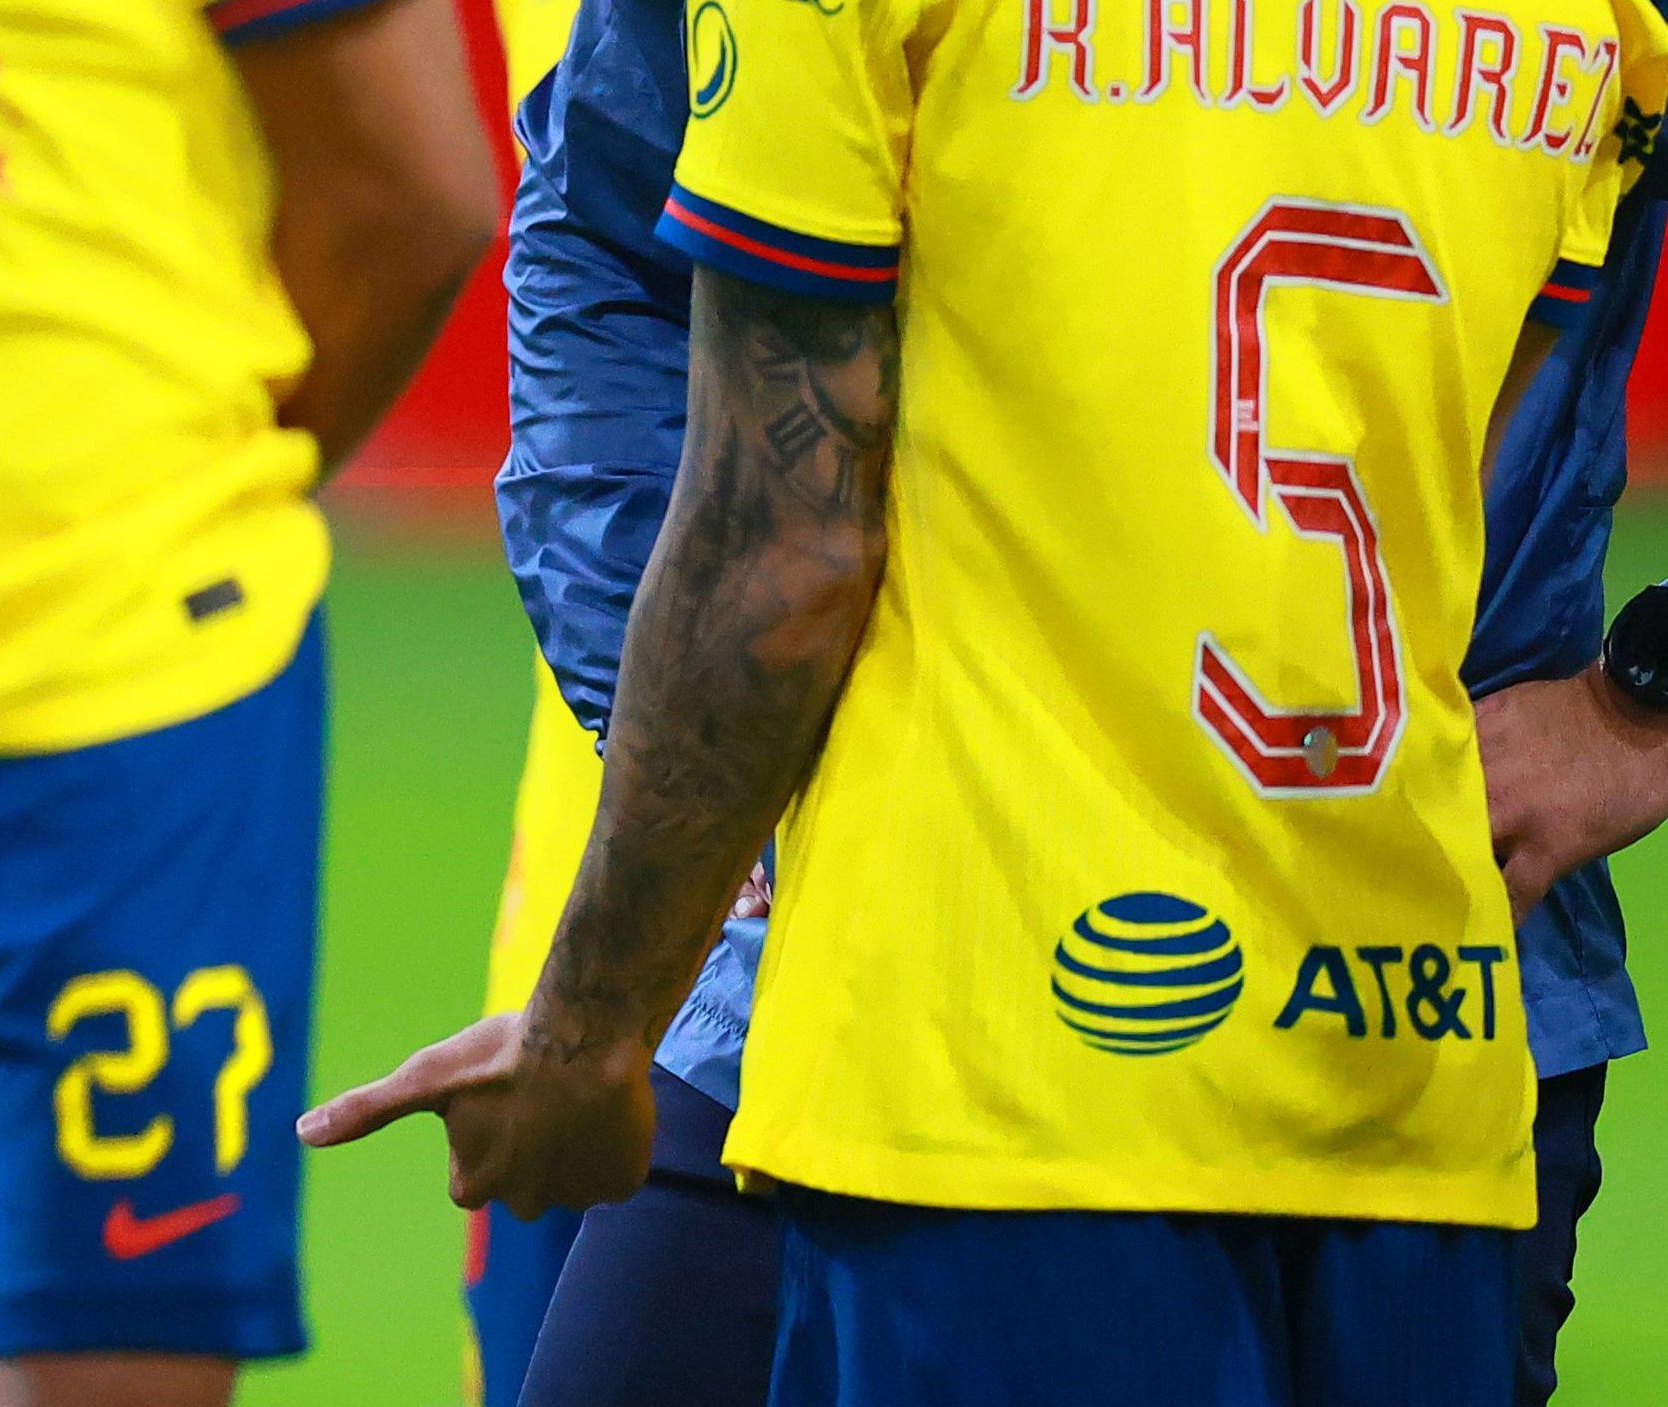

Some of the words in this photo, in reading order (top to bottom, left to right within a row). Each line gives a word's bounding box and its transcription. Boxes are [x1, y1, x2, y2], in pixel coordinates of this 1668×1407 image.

[1192, 195, 1451, 800] 5
[47, 963, 273, 1181] 27
[1274, 944, 1510, 1041] AT&T
